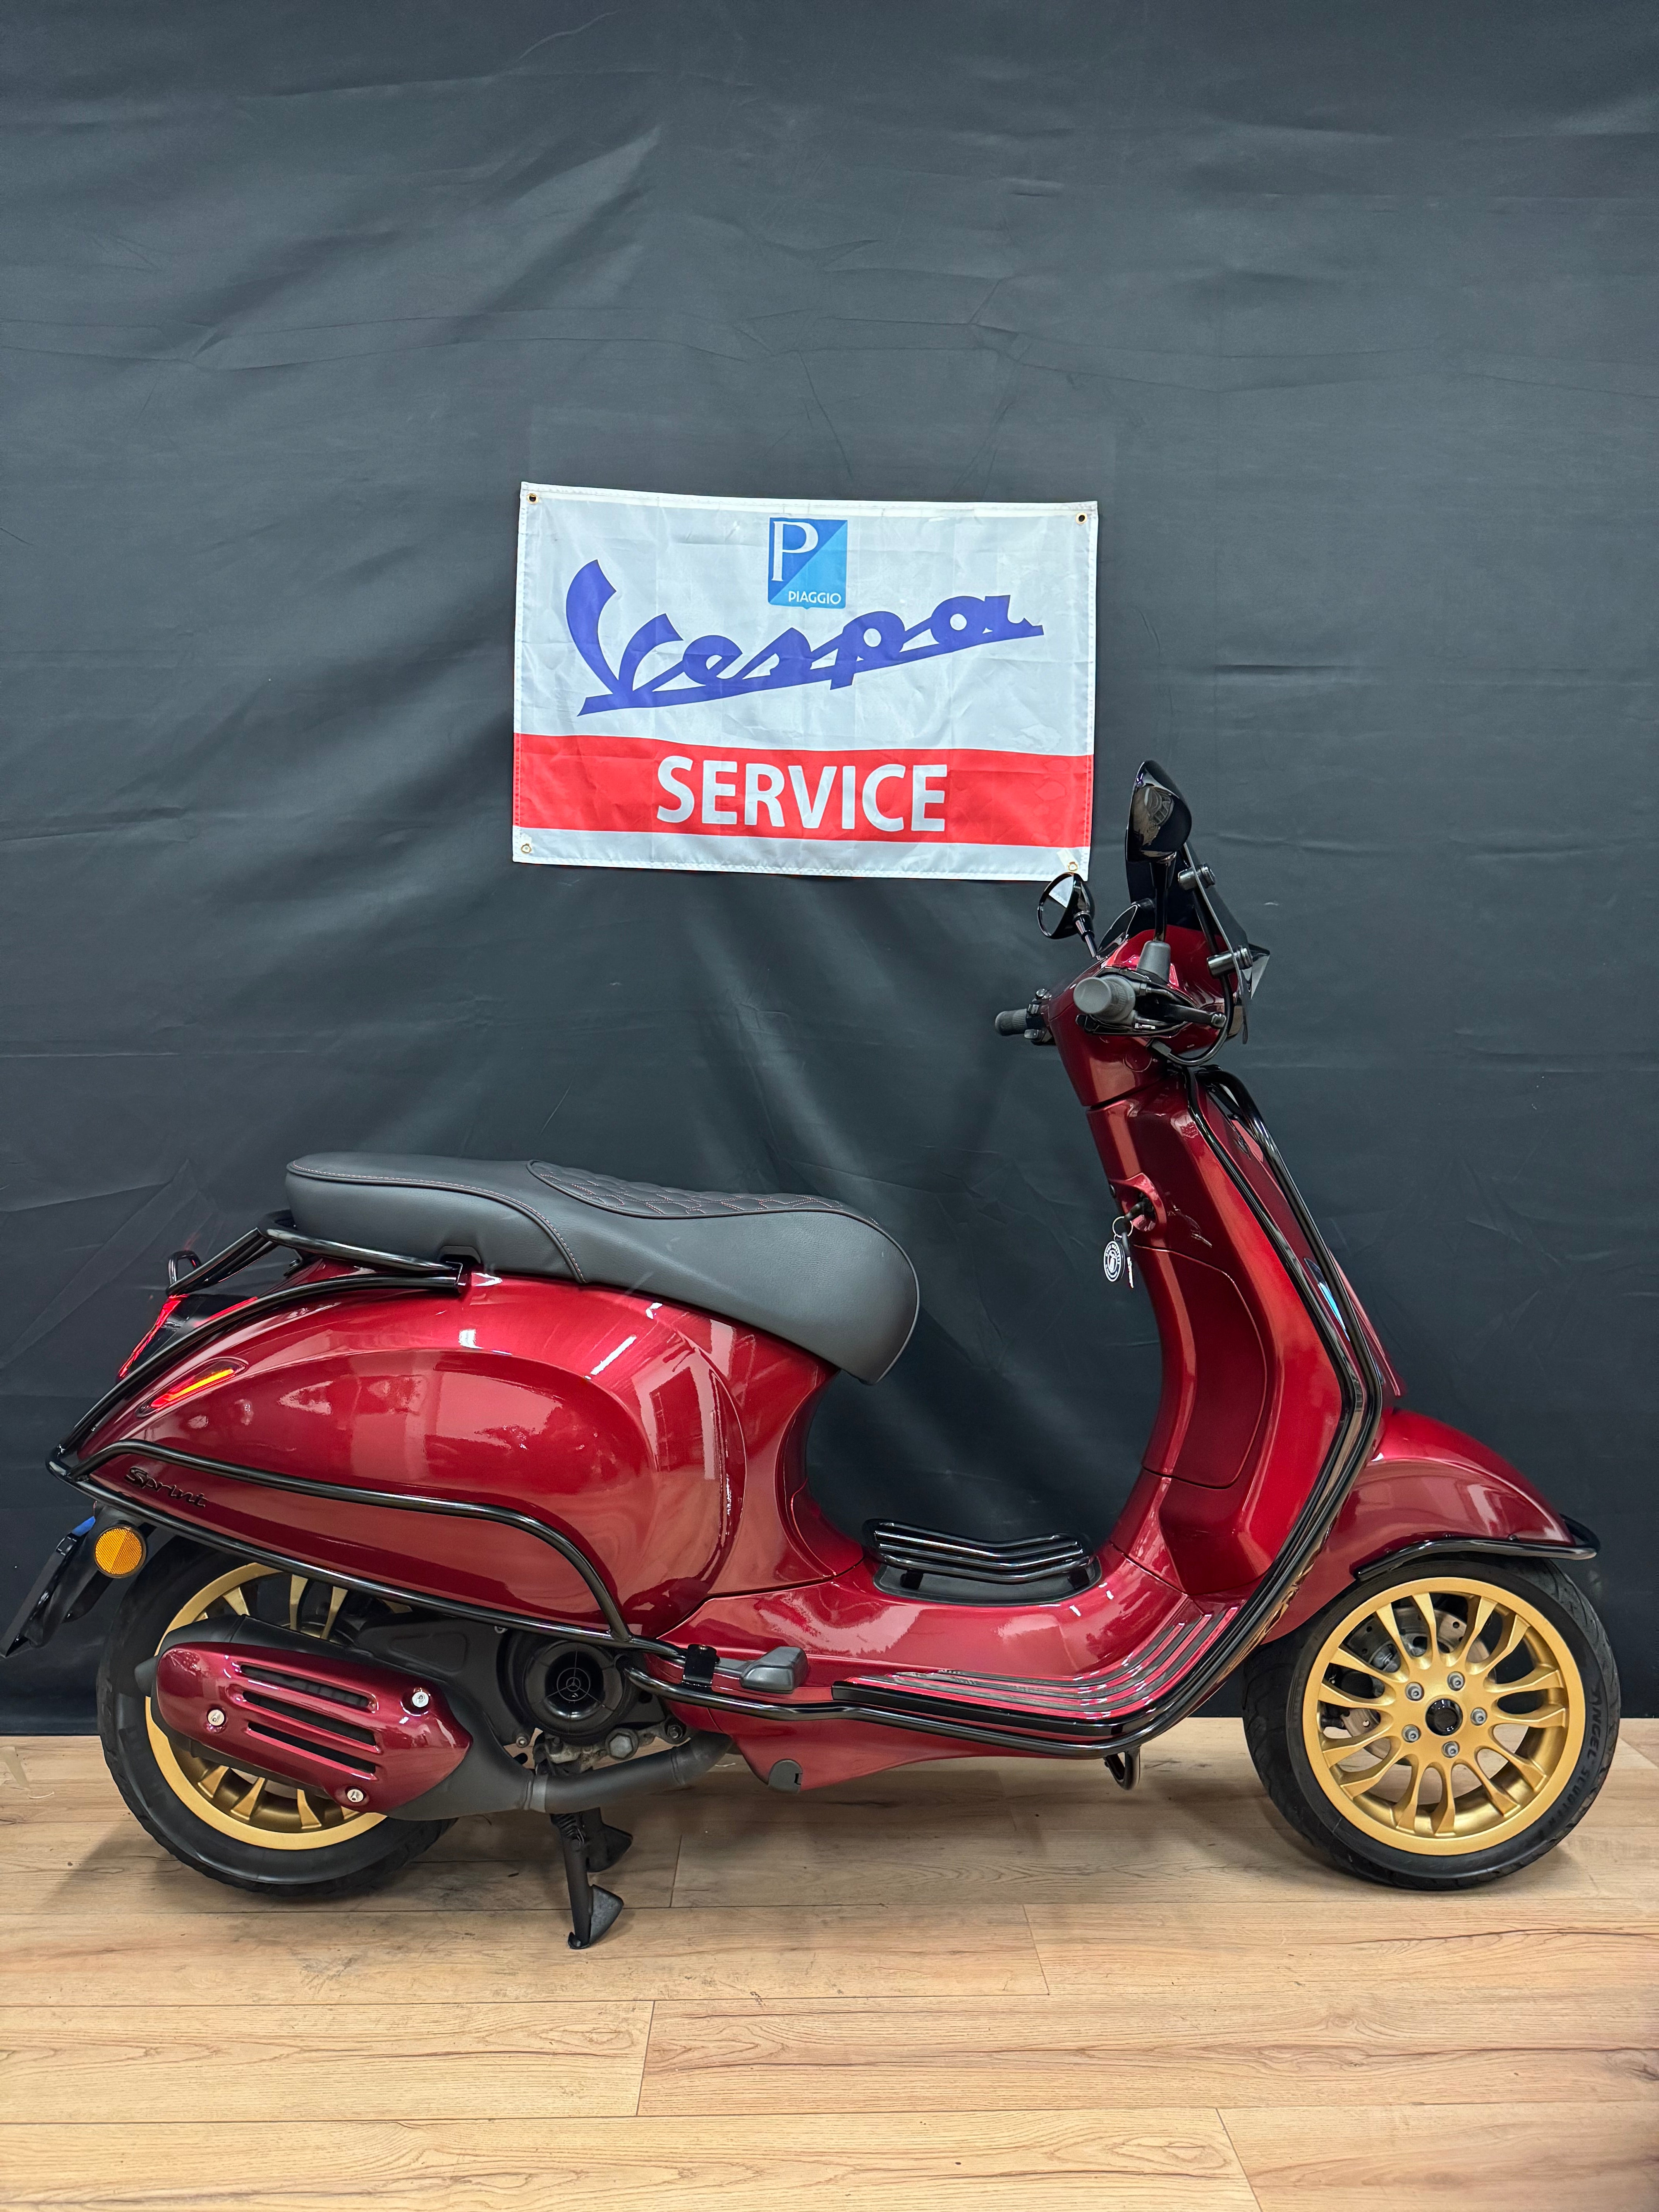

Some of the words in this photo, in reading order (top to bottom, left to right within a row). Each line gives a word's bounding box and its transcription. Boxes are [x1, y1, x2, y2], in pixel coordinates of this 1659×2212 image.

[771, 521, 818, 582] P
[788, 590, 842, 605] PIAGGIO
[566, 560, 1044, 716] Vespa
[656, 755, 948, 832] SERVICE
[124, 1466, 208, 1508] Sprint
[1587, 1679, 1602, 1759] ANGEL
